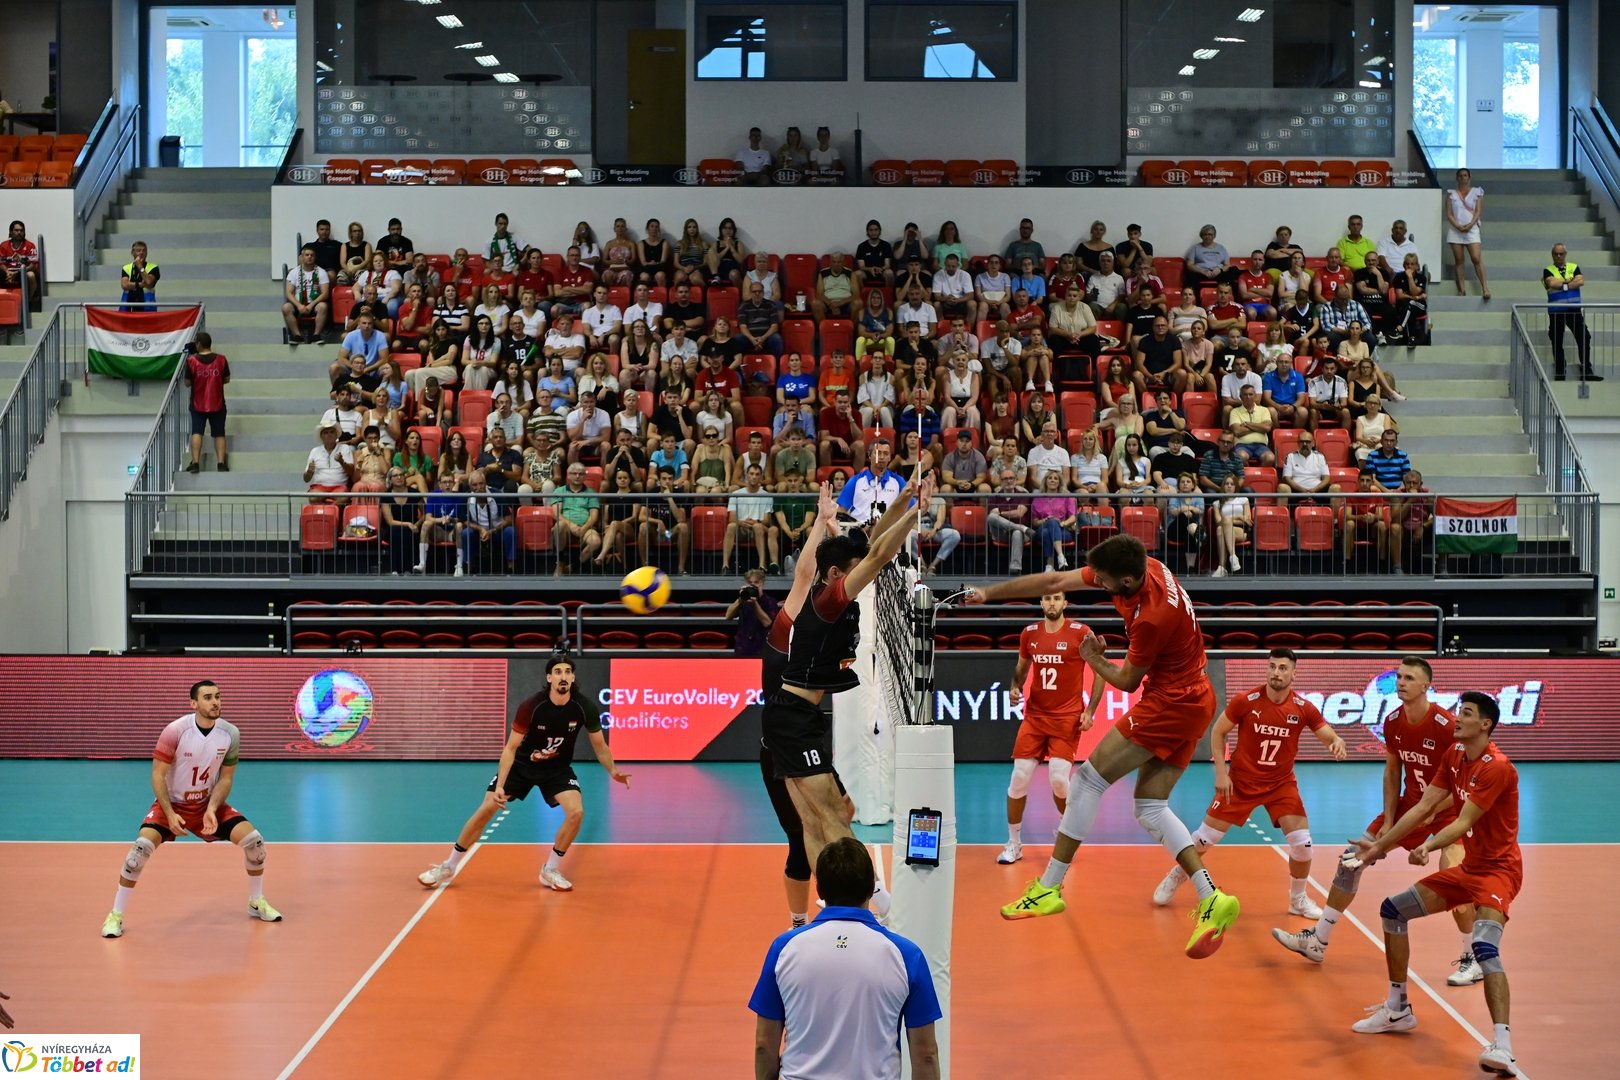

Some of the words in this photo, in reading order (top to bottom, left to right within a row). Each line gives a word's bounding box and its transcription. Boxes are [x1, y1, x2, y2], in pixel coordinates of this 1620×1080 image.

[486, 168, 505, 180] BH
[1072, 172, 1089, 182] BH
[1360, 172, 1377, 183] BH
[1330, 281, 1336, 290] 9
[515, 349, 526, 360] 18
[1224, 355, 1236, 370] 7
[1449, 518, 1508, 533] SZOLNOK
[1033, 654, 1064, 664] VESTEL
[1040, 668, 1057, 690] 12
[598, 688, 638, 705] CEV
[643, 688, 740, 708] EuroVolley
[600, 712, 688, 729] Qualifiers
[1254, 723, 1290, 737] VESTEL
[803, 749, 821, 766] 18
[1260, 740, 1281, 762] 17
[1399, 750, 1432, 766] VESTEL
[192, 766, 211, 786] 14
[1414, 769, 1428, 792] 5
[1212, 800, 1220, 810] 17
